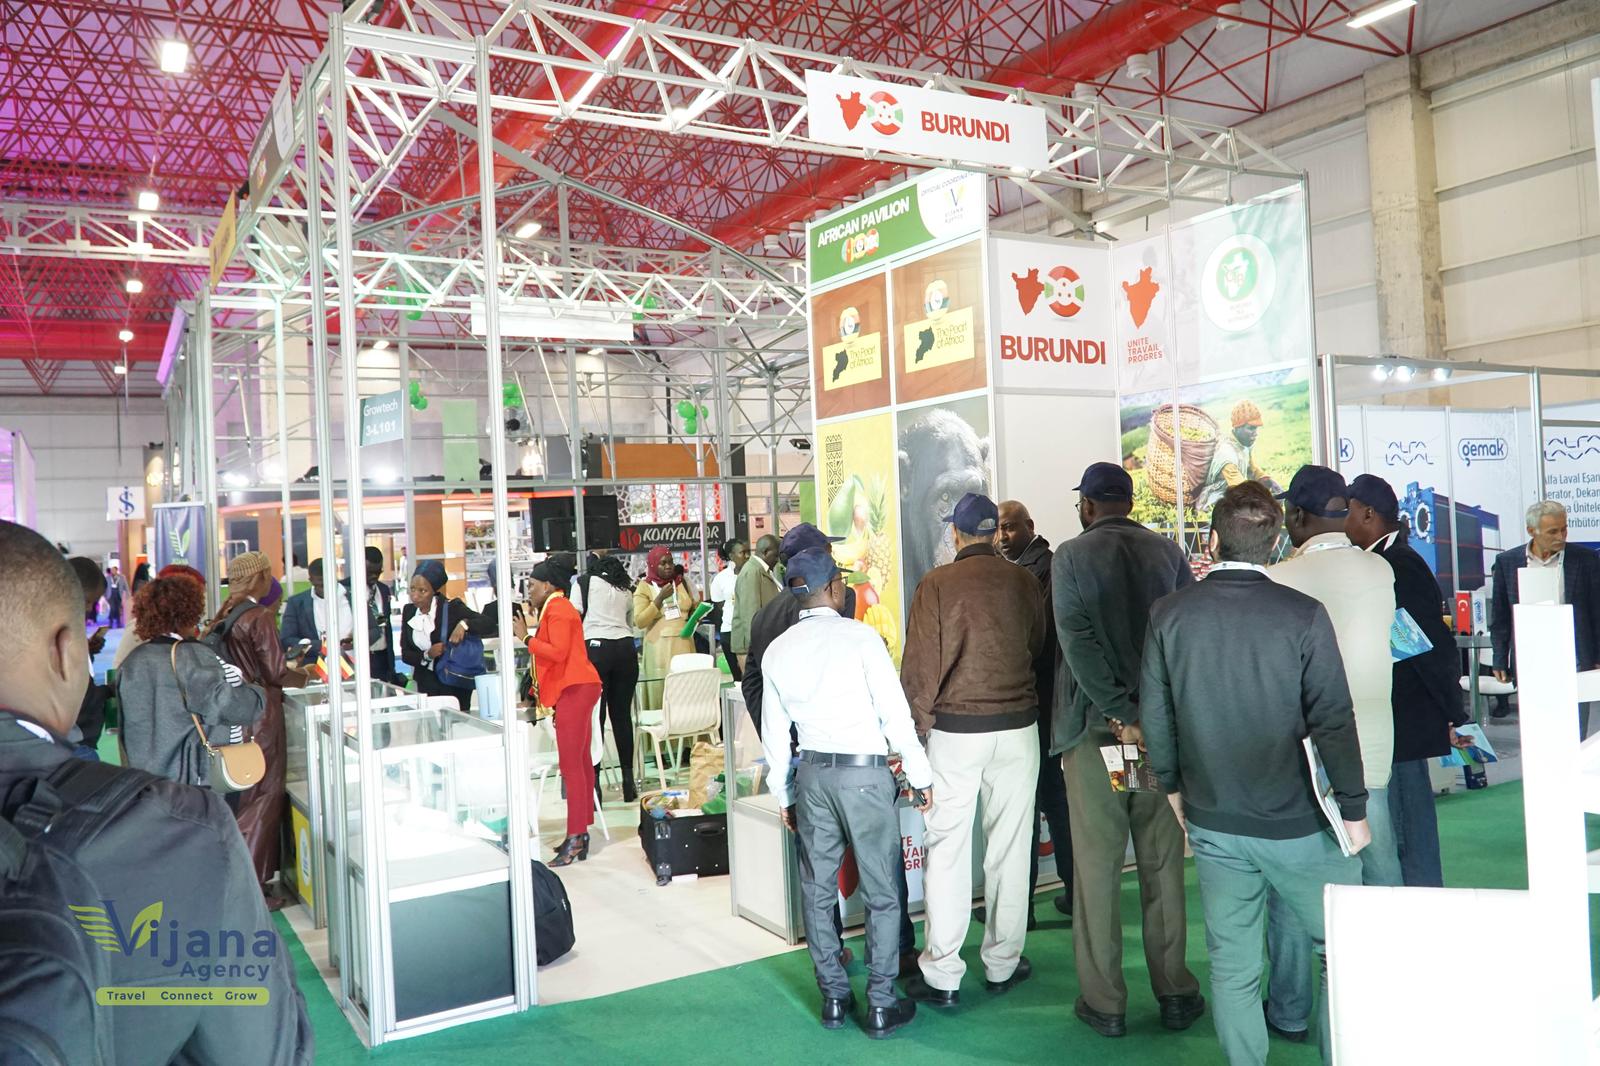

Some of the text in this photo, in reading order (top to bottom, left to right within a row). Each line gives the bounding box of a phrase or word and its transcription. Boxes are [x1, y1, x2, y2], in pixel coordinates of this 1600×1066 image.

[921, 110, 1010, 143] BURUNDI
[817, 196, 910, 248] AFRICAN PAVILION
[1000, 334, 1106, 365] BURUNDI
[1127, 337, 1149, 349] UNITE
[1128, 344, 1160, 356] TRAVAIL
[1128, 351, 1163, 364] PROGRES
[363, 398, 398, 417] Growtech
[1462, 438, 1504, 467] gemak
[1560, 472, 1580, 484] Laval
